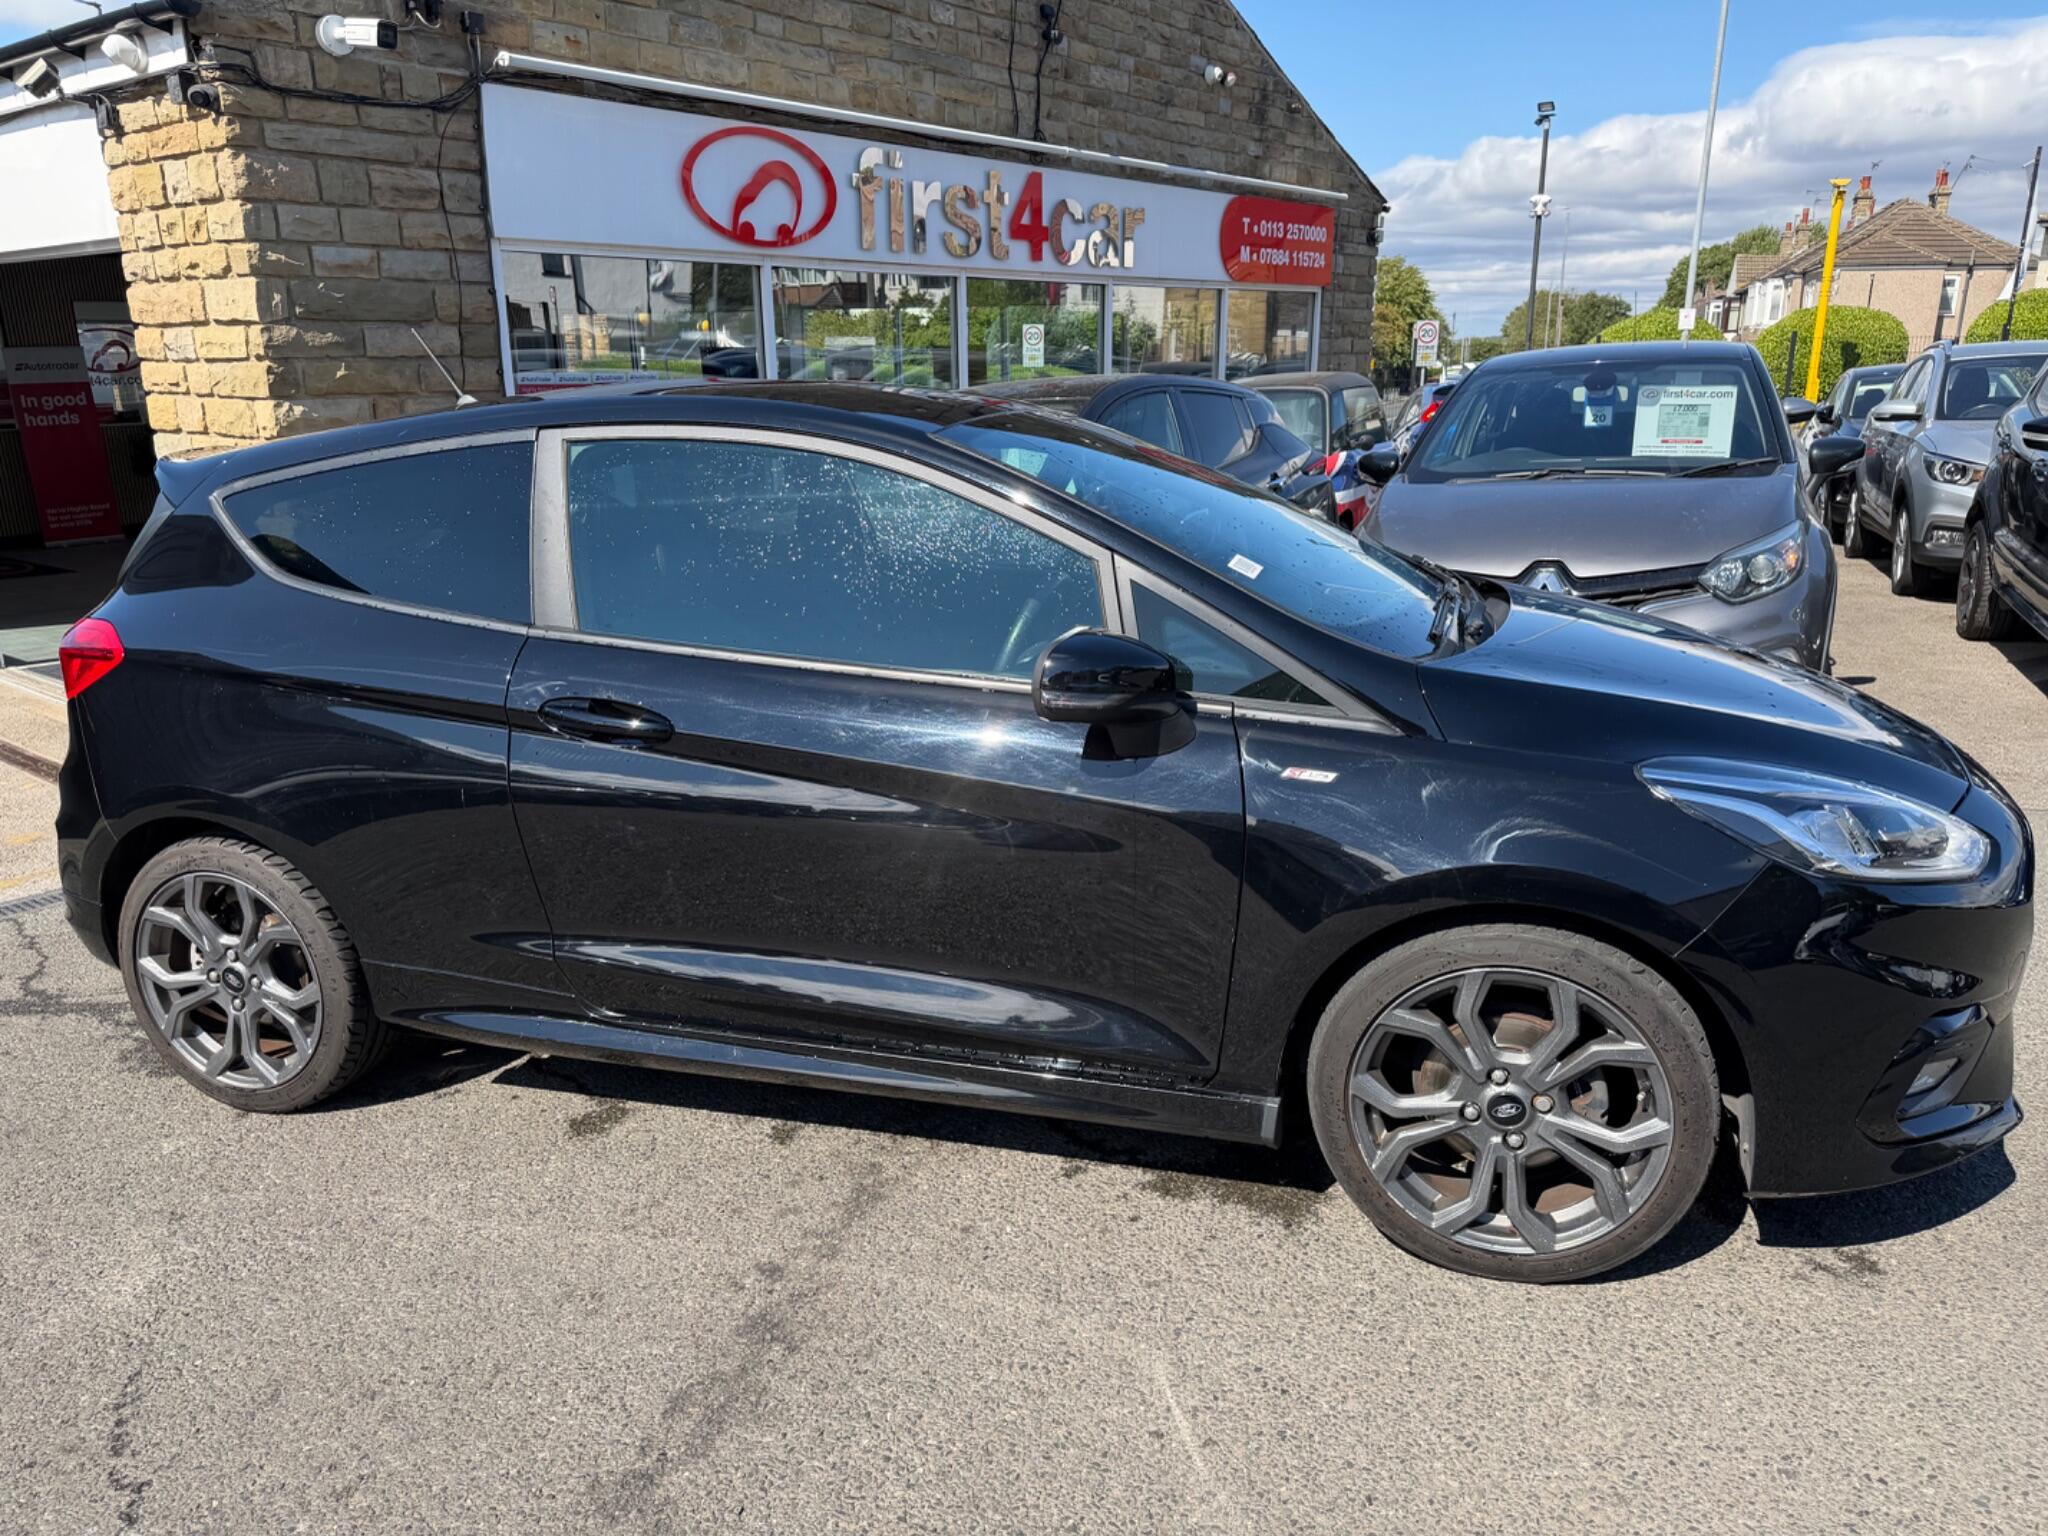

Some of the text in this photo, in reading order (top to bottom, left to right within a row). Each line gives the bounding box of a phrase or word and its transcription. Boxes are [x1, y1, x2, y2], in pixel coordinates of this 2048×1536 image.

[851, 146, 1146, 269] first4car
[1242, 217, 1327, 242] T 0113 2570000
[1240, 245, 1325, 268] M 07884 115724
[1027, 331, 1039, 341] 20
[1421, 327, 1434, 338] 20
[21, 392, 87, 410] In good
[1663, 389, 1733, 399] first4car.com
[24, 411, 80, 426] hands
